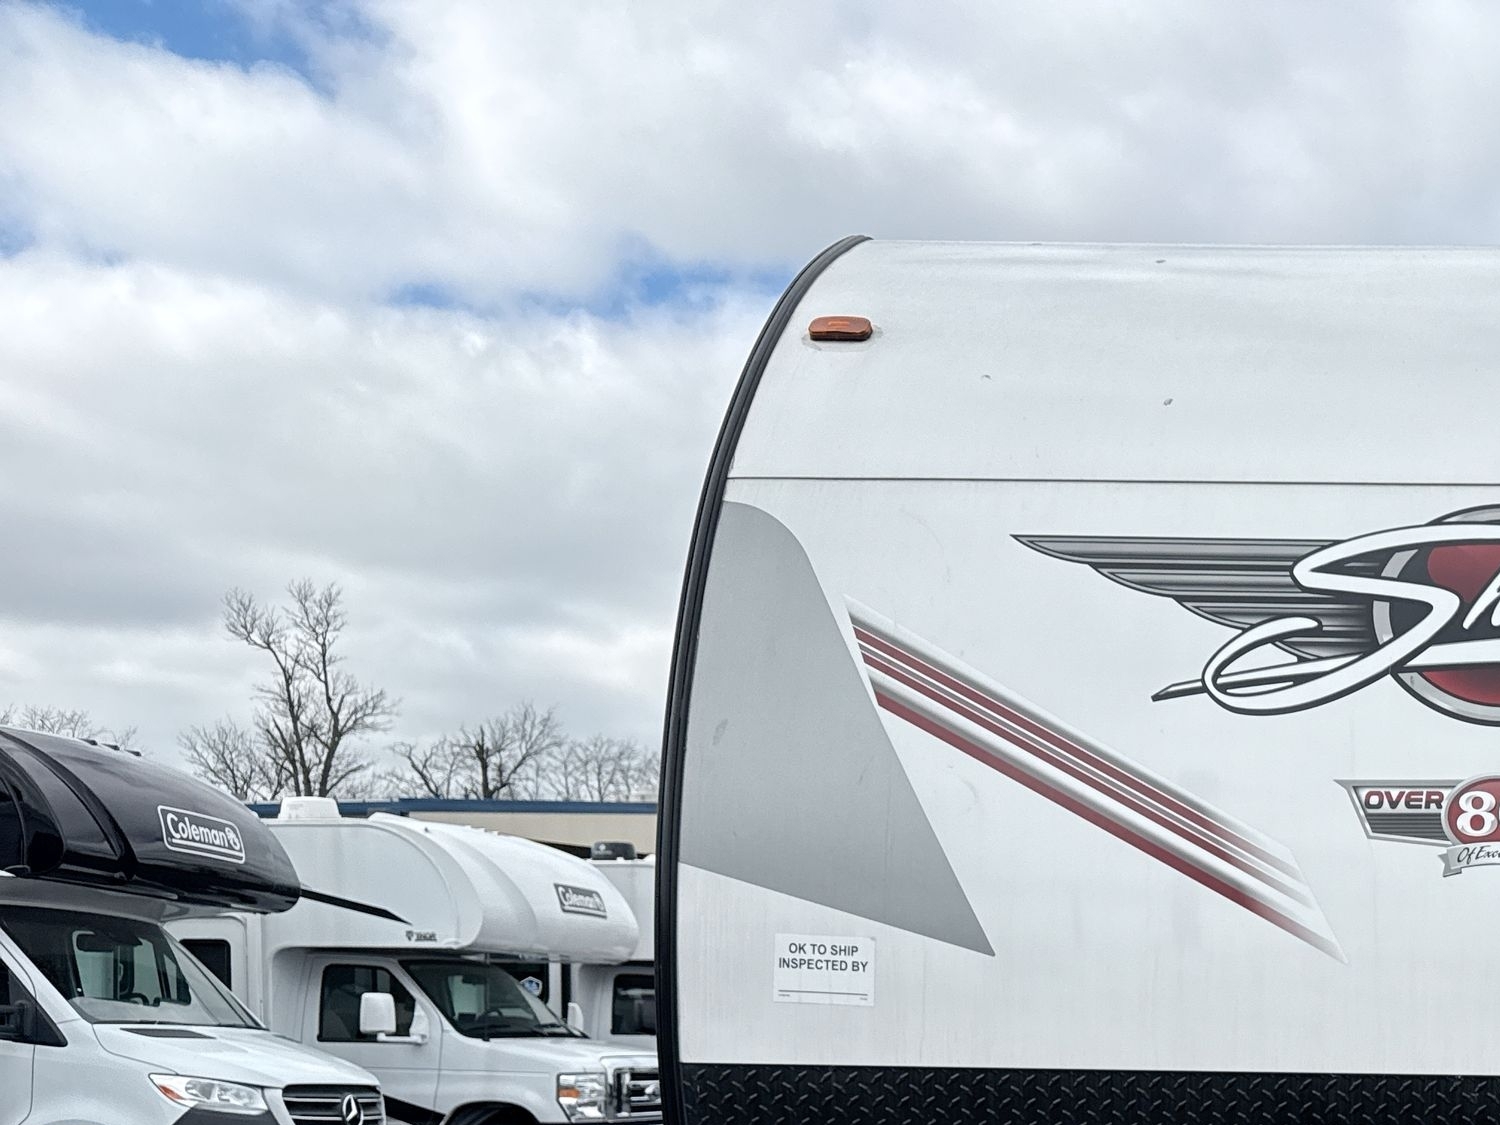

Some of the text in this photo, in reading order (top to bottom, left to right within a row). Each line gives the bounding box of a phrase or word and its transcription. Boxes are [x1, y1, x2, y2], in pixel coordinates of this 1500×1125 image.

[1364, 790, 1445, 809] OVER
[166, 812, 229, 849] Coleman
[788, 942, 859, 957] OK TO SHIP
[778, 957, 869, 973] INSPECTED BY
